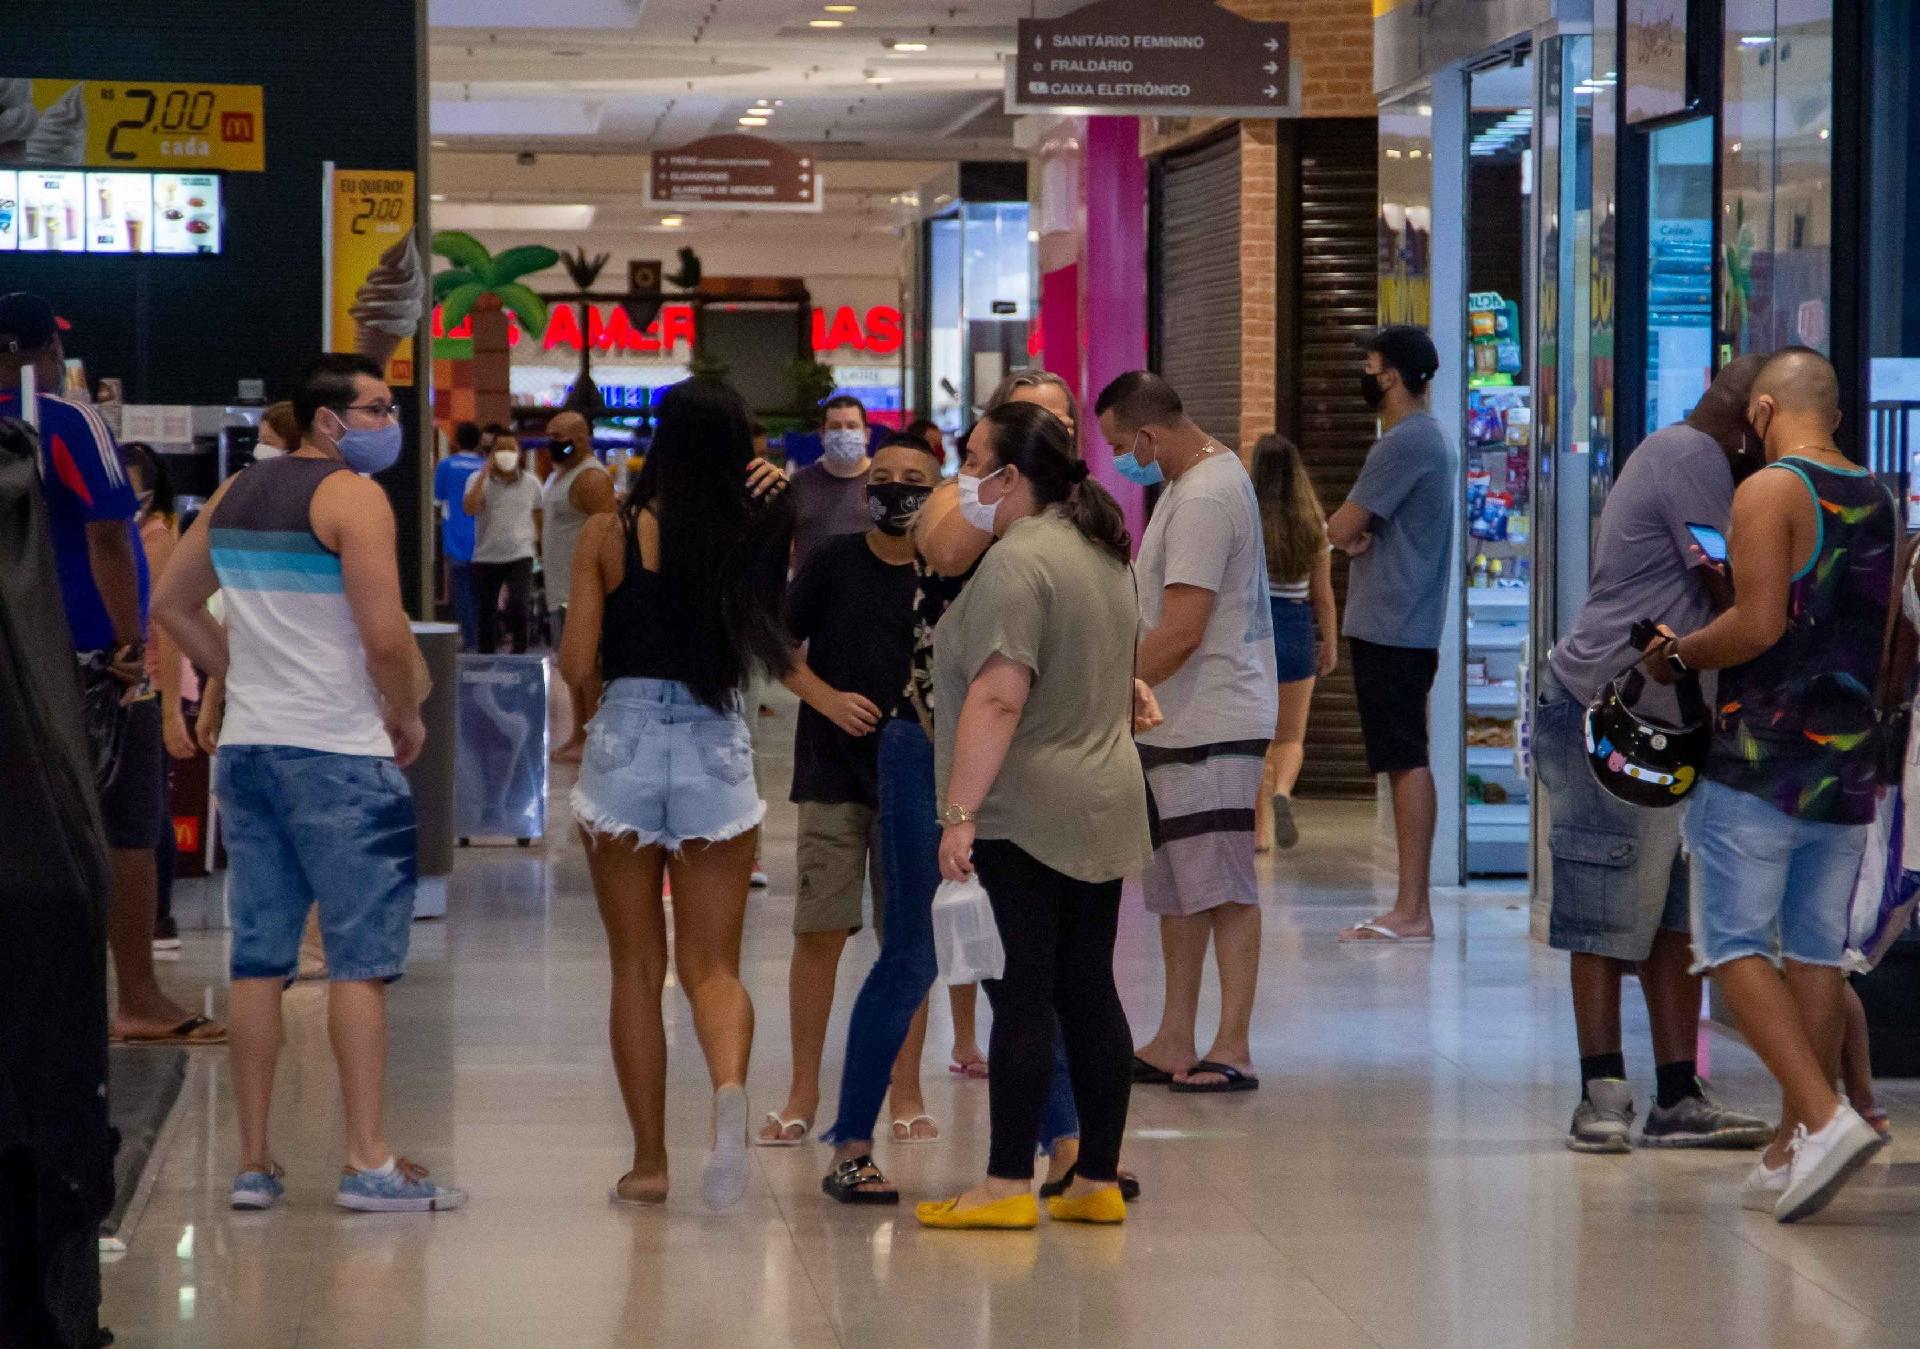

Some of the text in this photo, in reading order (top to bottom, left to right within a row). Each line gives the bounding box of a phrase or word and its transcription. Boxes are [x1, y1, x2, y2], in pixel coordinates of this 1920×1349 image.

[1052, 34, 1205, 49] SANITÁRIO FEMININO
[1050, 59, 1134, 73] FRALDÁRIO
[1051, 80, 1191, 97] CAIXA ELETRÔNICO
[160, 137, 209, 156] cada
[341, 179, 356, 193] EU
